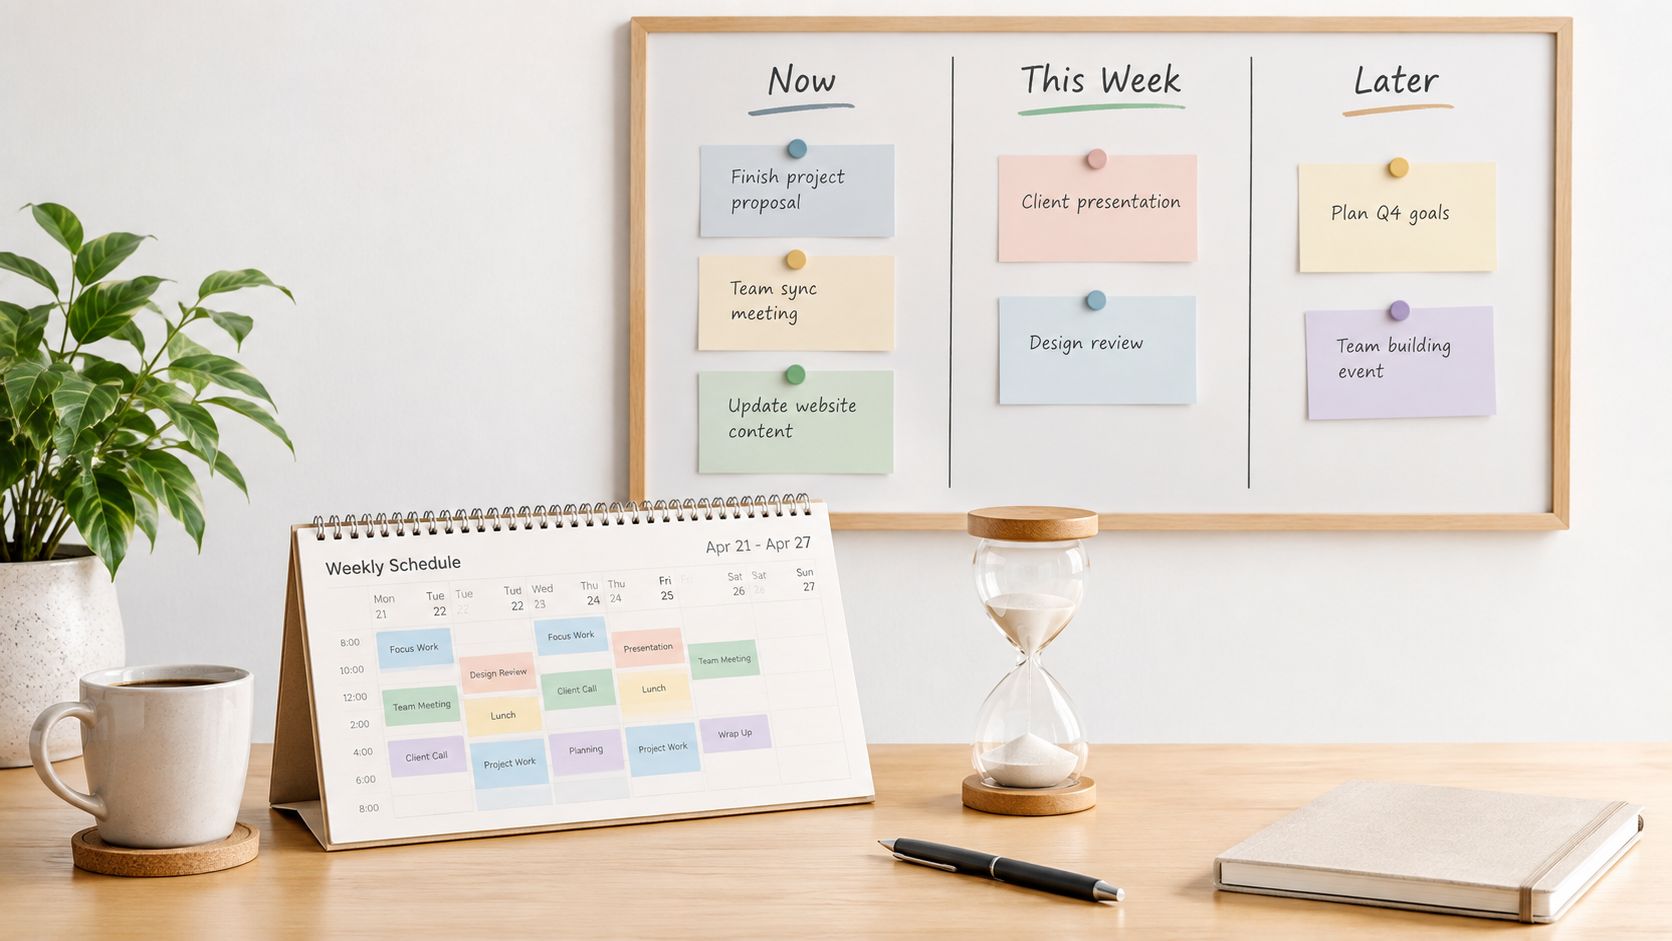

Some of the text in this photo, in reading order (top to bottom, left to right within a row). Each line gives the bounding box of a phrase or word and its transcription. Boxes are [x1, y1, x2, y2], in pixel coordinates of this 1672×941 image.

[769, 63, 835, 95] Now
[1021, 63, 1181, 93] This Week
[1355, 65, 1439, 94] Later
[732, 168, 845, 189] Finish project
[732, 194, 800, 215] proposal
[1022, 193, 1180, 214] Client presentation
[1332, 204, 1449, 226] Plan Q4 goals
[730, 281, 816, 300] Team sync
[732, 306, 797, 325] meeting
[1031, 335, 1143, 355] Design review
[1337, 337, 1450, 358] Team building
[1339, 364, 1384, 378] event
[729, 396, 856, 418] Update website
[729, 424, 793, 438] content
[706, 541, 730, 556] Apr
[736, 540, 751, 552] 21
[766, 538, 790, 552] Apr
[795, 536, 810, 548] 27
[326, 556, 460, 576] Weekly Schedule
[728, 573, 742, 581] Sat
[752, 571, 766, 579] Sat
[796, 568, 813, 577] Sun
[608, 580, 625, 588] Thu
[659, 576, 671, 585] Fri
[532, 584, 553, 593] Wed
[580, 581, 598, 590] Thu
[804, 582, 814, 591] 27
[456, 590, 473, 598] Tue
[661, 591, 673, 600] 25
[733, 586, 745, 596] 26
[374, 595, 395, 603] Mon
[426, 592, 444, 600] Tue
[587, 596, 600, 605] 24
[610, 594, 621, 603] 24
[512, 601, 523, 611] 22
[535, 600, 546, 608] 23
[376, 610, 386, 619] 21
[434, 606, 446, 616] 22
[548, 631, 594, 640] Focus Work
[341, 639, 360, 647] 8:00
[417, 643, 438, 651] Work
[624, 643, 673, 653] Presentation
[340, 665, 364, 675] 10:00
[470, 668, 527, 680] Design Review
[557, 685, 597, 695] Client Call
[642, 684, 666, 693] Lunch
[343, 693, 367, 701] 12:00
[418, 701, 451, 709] Meeting
[491, 711, 516, 720] Lunch
[350, 720, 369, 729] 2:00
[740, 729, 752, 737] Up
[353, 747, 373, 756] 4:00
[569, 746, 603, 755] Planning
[639, 742, 688, 754] Project Work
[406, 751, 447, 762] Client Call
[484, 758, 536, 770] Project Work
[356, 775, 376, 784] 6:00
[359, 804, 379, 813] 8:00
